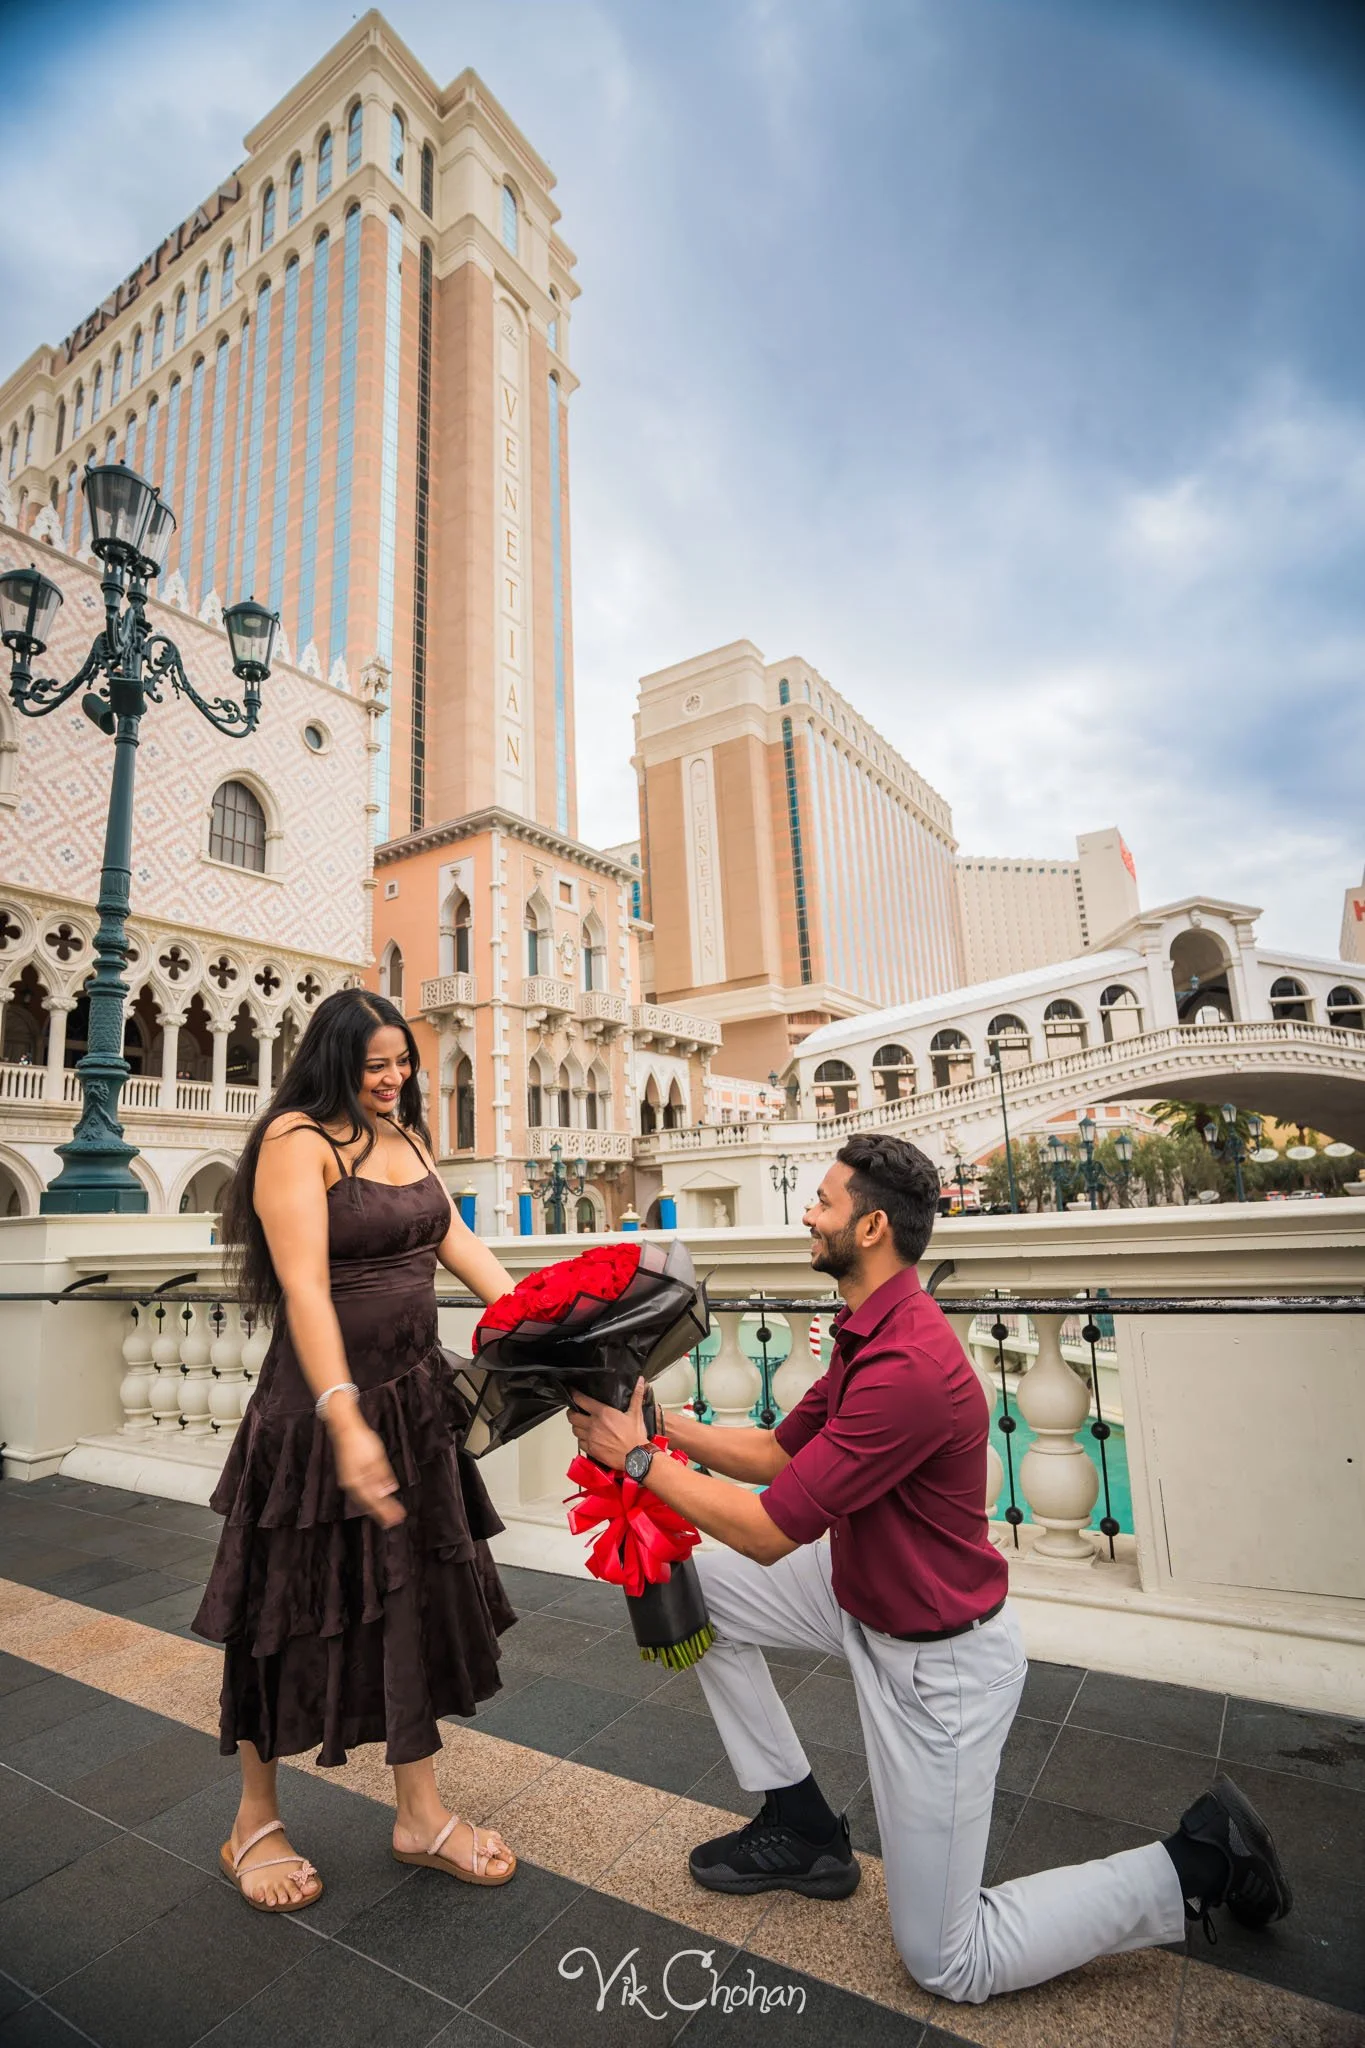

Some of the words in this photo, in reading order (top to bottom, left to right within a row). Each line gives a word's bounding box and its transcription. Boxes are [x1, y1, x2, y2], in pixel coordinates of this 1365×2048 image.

[58, 164, 244, 364] VENETIAN
[503, 387, 520, 767] VENETIAN
[696, 806, 713, 959] VENETIAN
